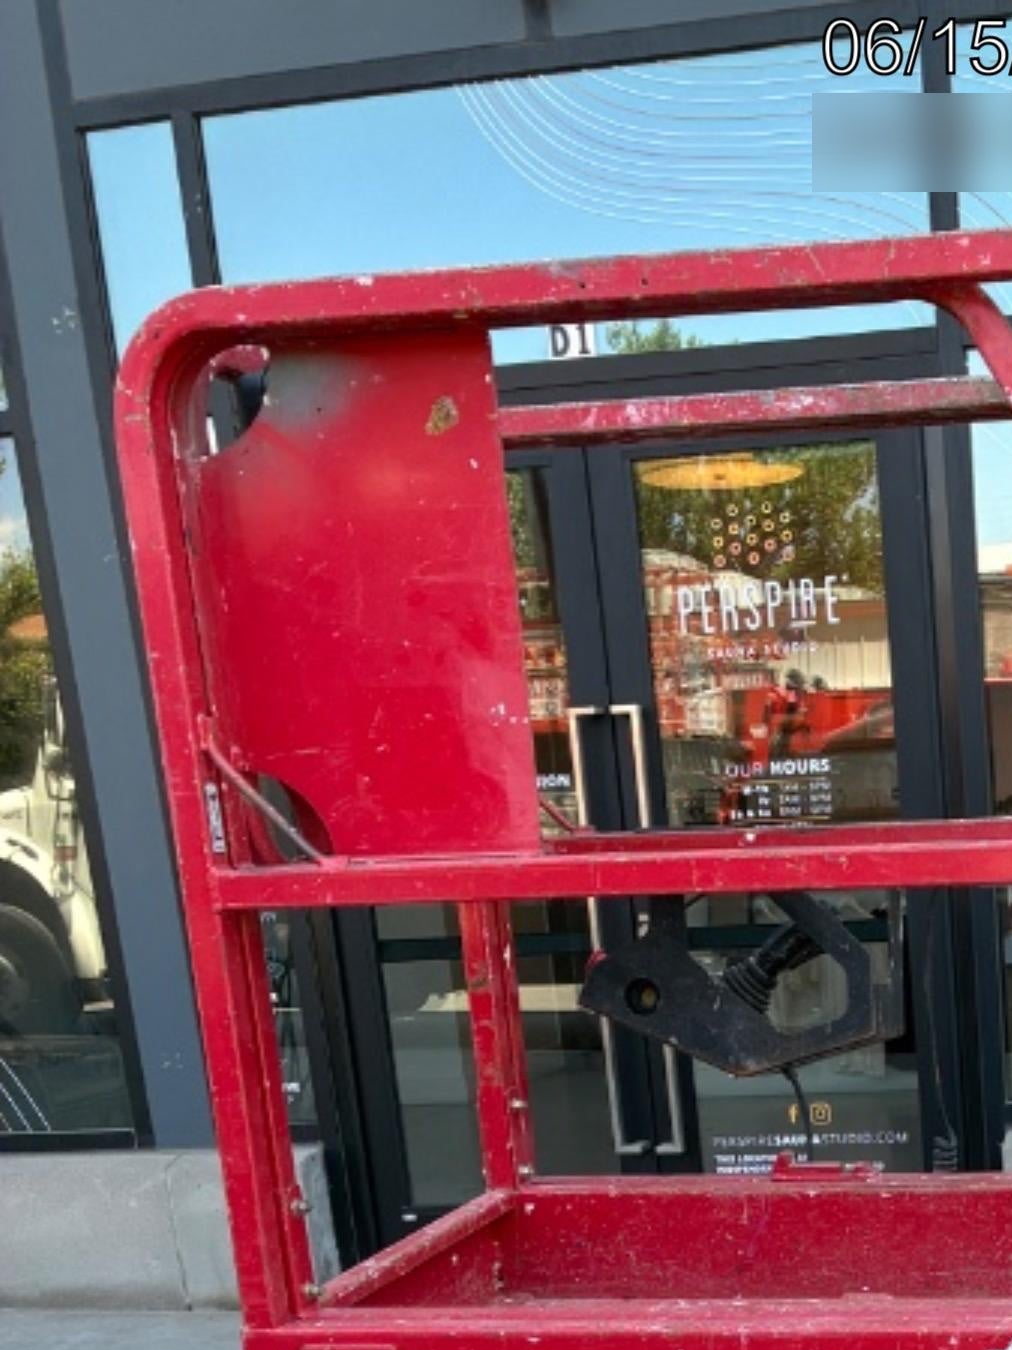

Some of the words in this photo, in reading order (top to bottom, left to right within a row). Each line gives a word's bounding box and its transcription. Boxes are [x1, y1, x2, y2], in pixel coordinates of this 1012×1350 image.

[551, 324, 591, 358] D1
[676, 574, 841, 637] PERSPIRE
[725, 760, 763, 778] OUR
[770, 757, 831, 776] HOURS
